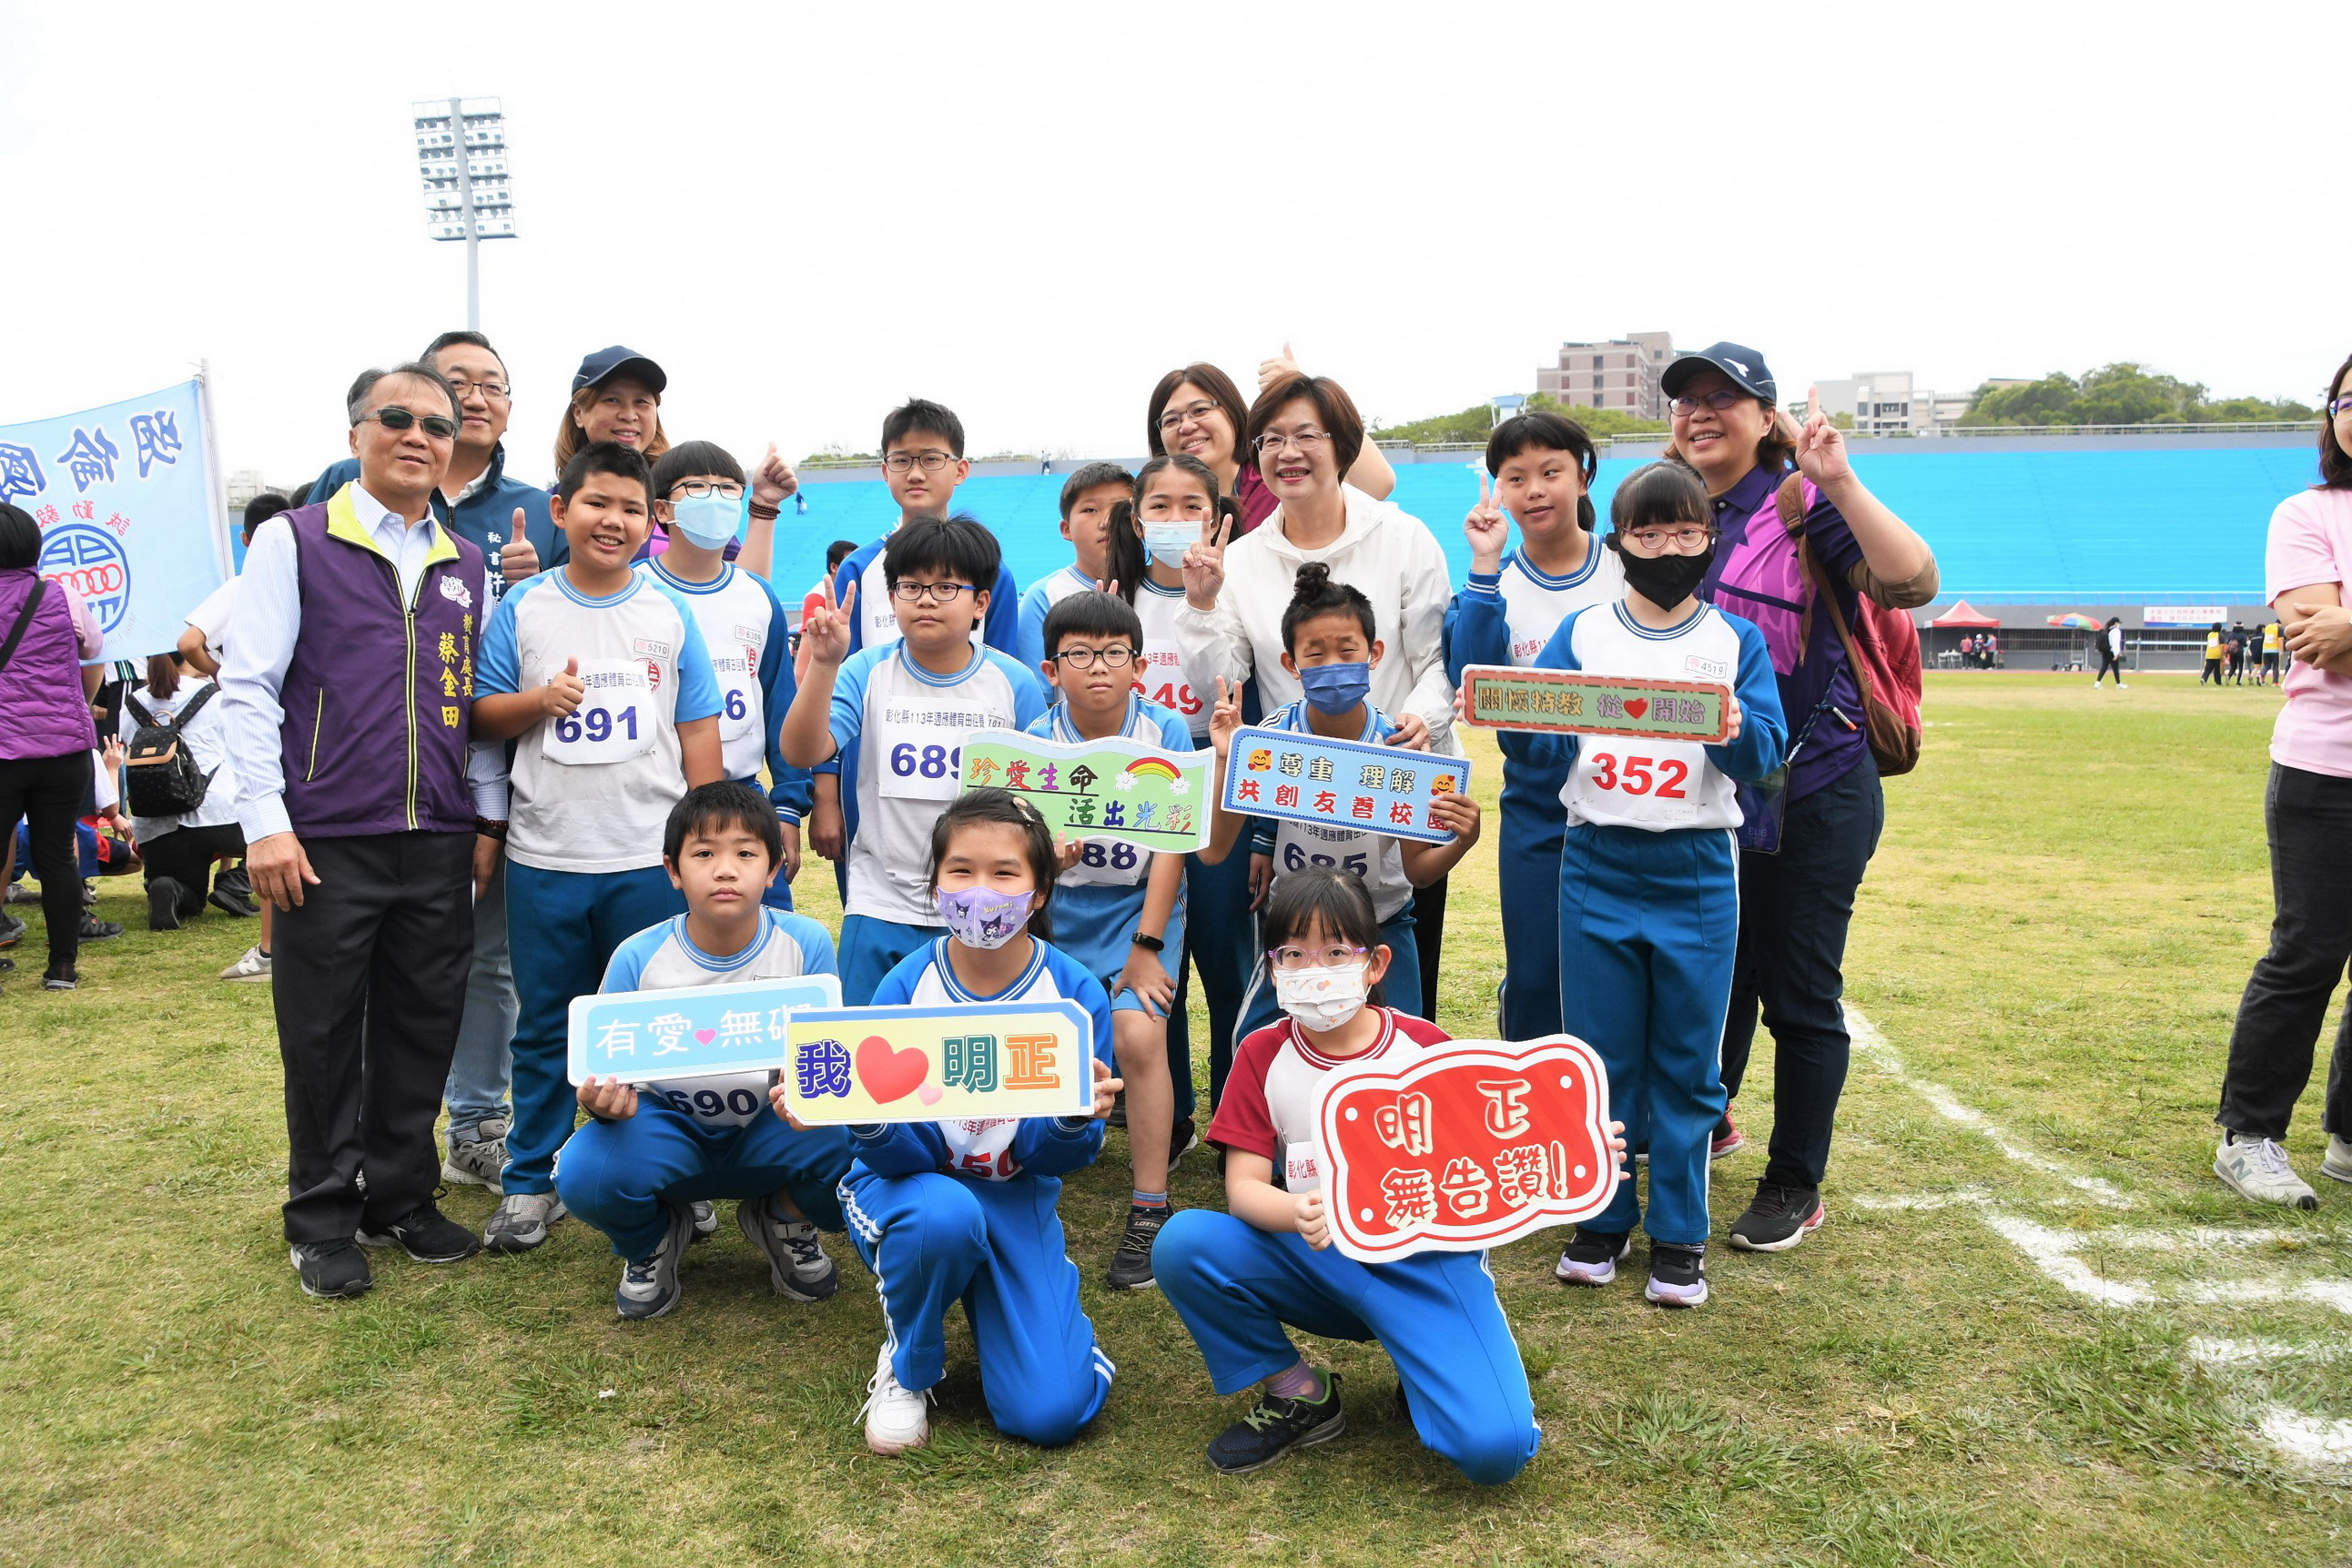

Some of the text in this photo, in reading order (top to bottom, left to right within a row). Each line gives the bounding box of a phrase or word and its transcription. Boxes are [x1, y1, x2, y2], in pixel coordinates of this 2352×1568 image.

[460, 612, 474, 697] 教育處長
[647, 642, 667, 655] 5210
[1514, 638, 1548, 658] 彰化縣1
[438, 632, 460, 729] 蔡金田
[1701, 663, 1724, 675] 4519
[1477, 687, 1706, 724] 關懷特教 從 開始
[555, 706, 638, 744] 691
[969, 756, 1099, 794] 珍愛生命
[1279, 753, 1416, 794] 尊重 理解
[1591, 753, 1688, 799] 352
[1069, 797, 1193, 833] 活出光彩
[596, 1011, 692, 1059] 有愛
[795, 1033, 1060, 1099] 我 明正
[665, 1088, 759, 1118] 690
